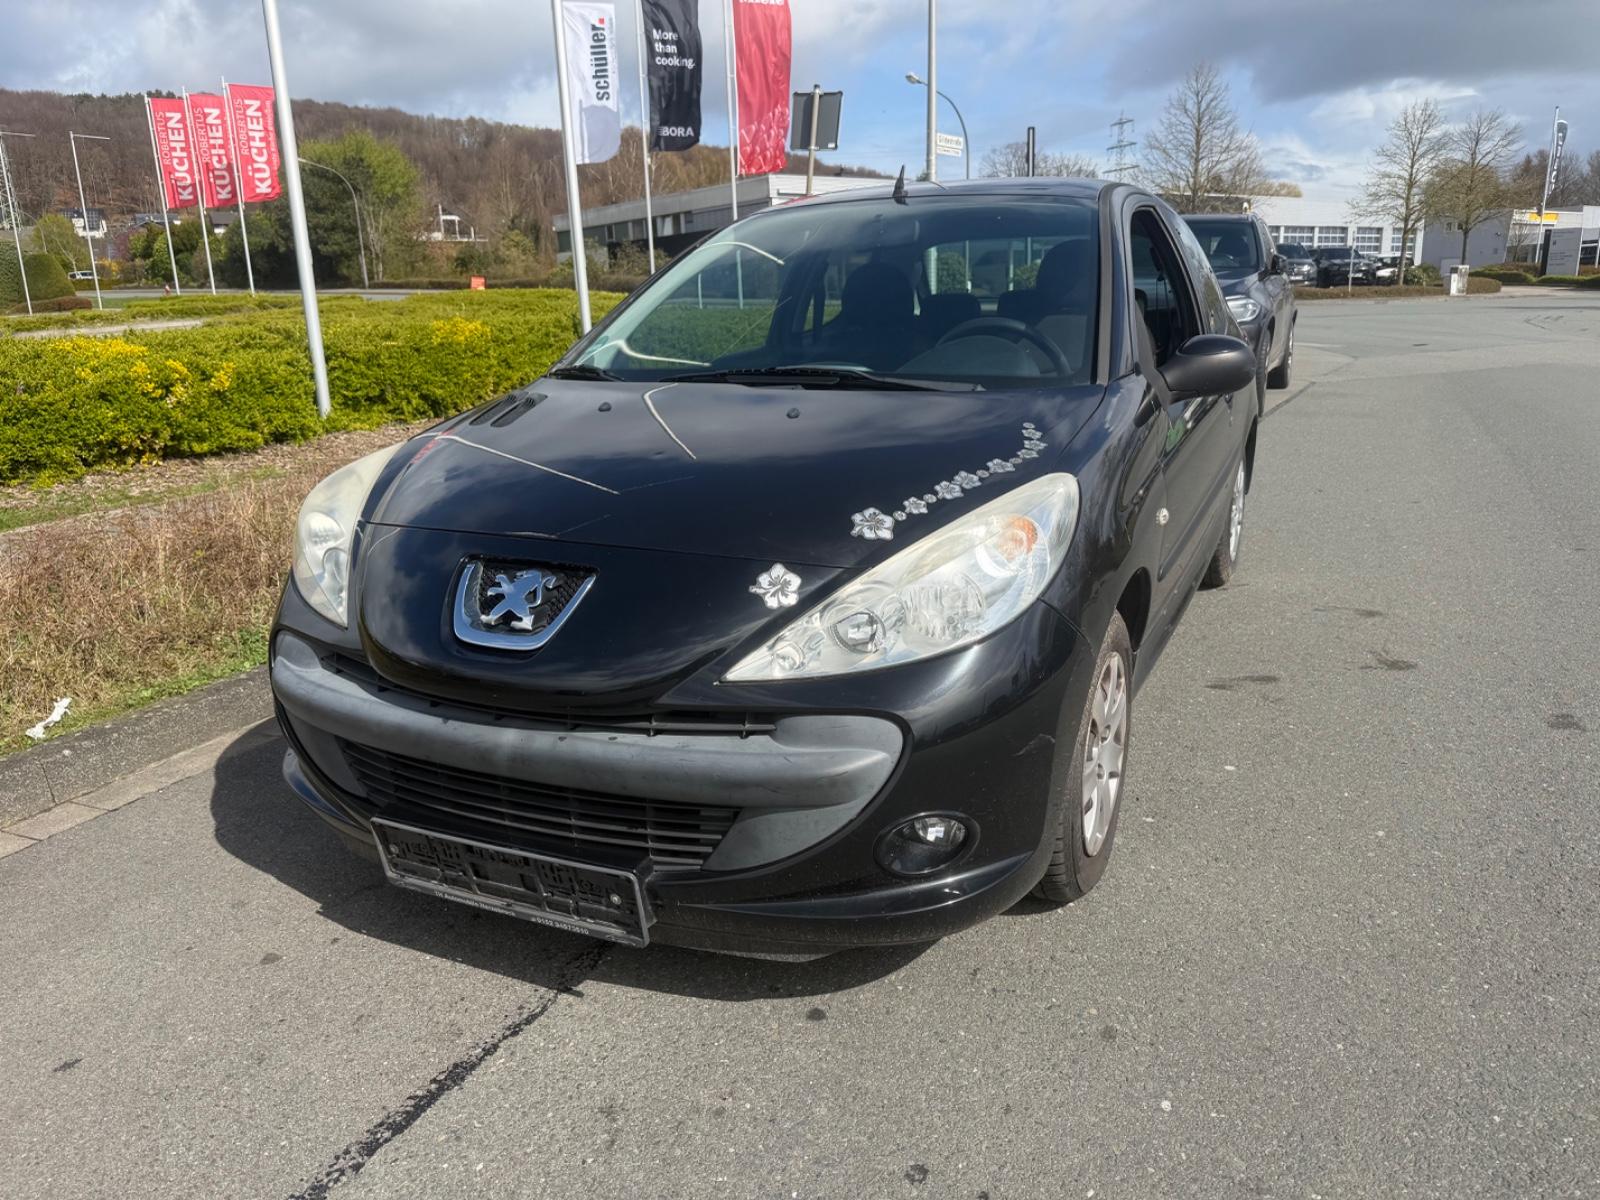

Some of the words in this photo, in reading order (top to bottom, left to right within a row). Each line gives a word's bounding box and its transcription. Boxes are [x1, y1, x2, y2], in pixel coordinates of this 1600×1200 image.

[590, 17, 610, 102] schüller.
[652, 28, 679, 41] More
[654, 42, 678, 54] than
[655, 55, 696, 69] cooking.
[156, 111, 171, 165] ROBERTUS
[193, 107, 211, 162] ROBERTUS
[204, 108, 231, 199] KÜCHEN
[234, 98, 250, 156] ROBERTUS
[244, 99, 272, 194] KÜCHEN
[662, 125, 694, 138] BORA
[165, 112, 193, 200] KÜCHEN
